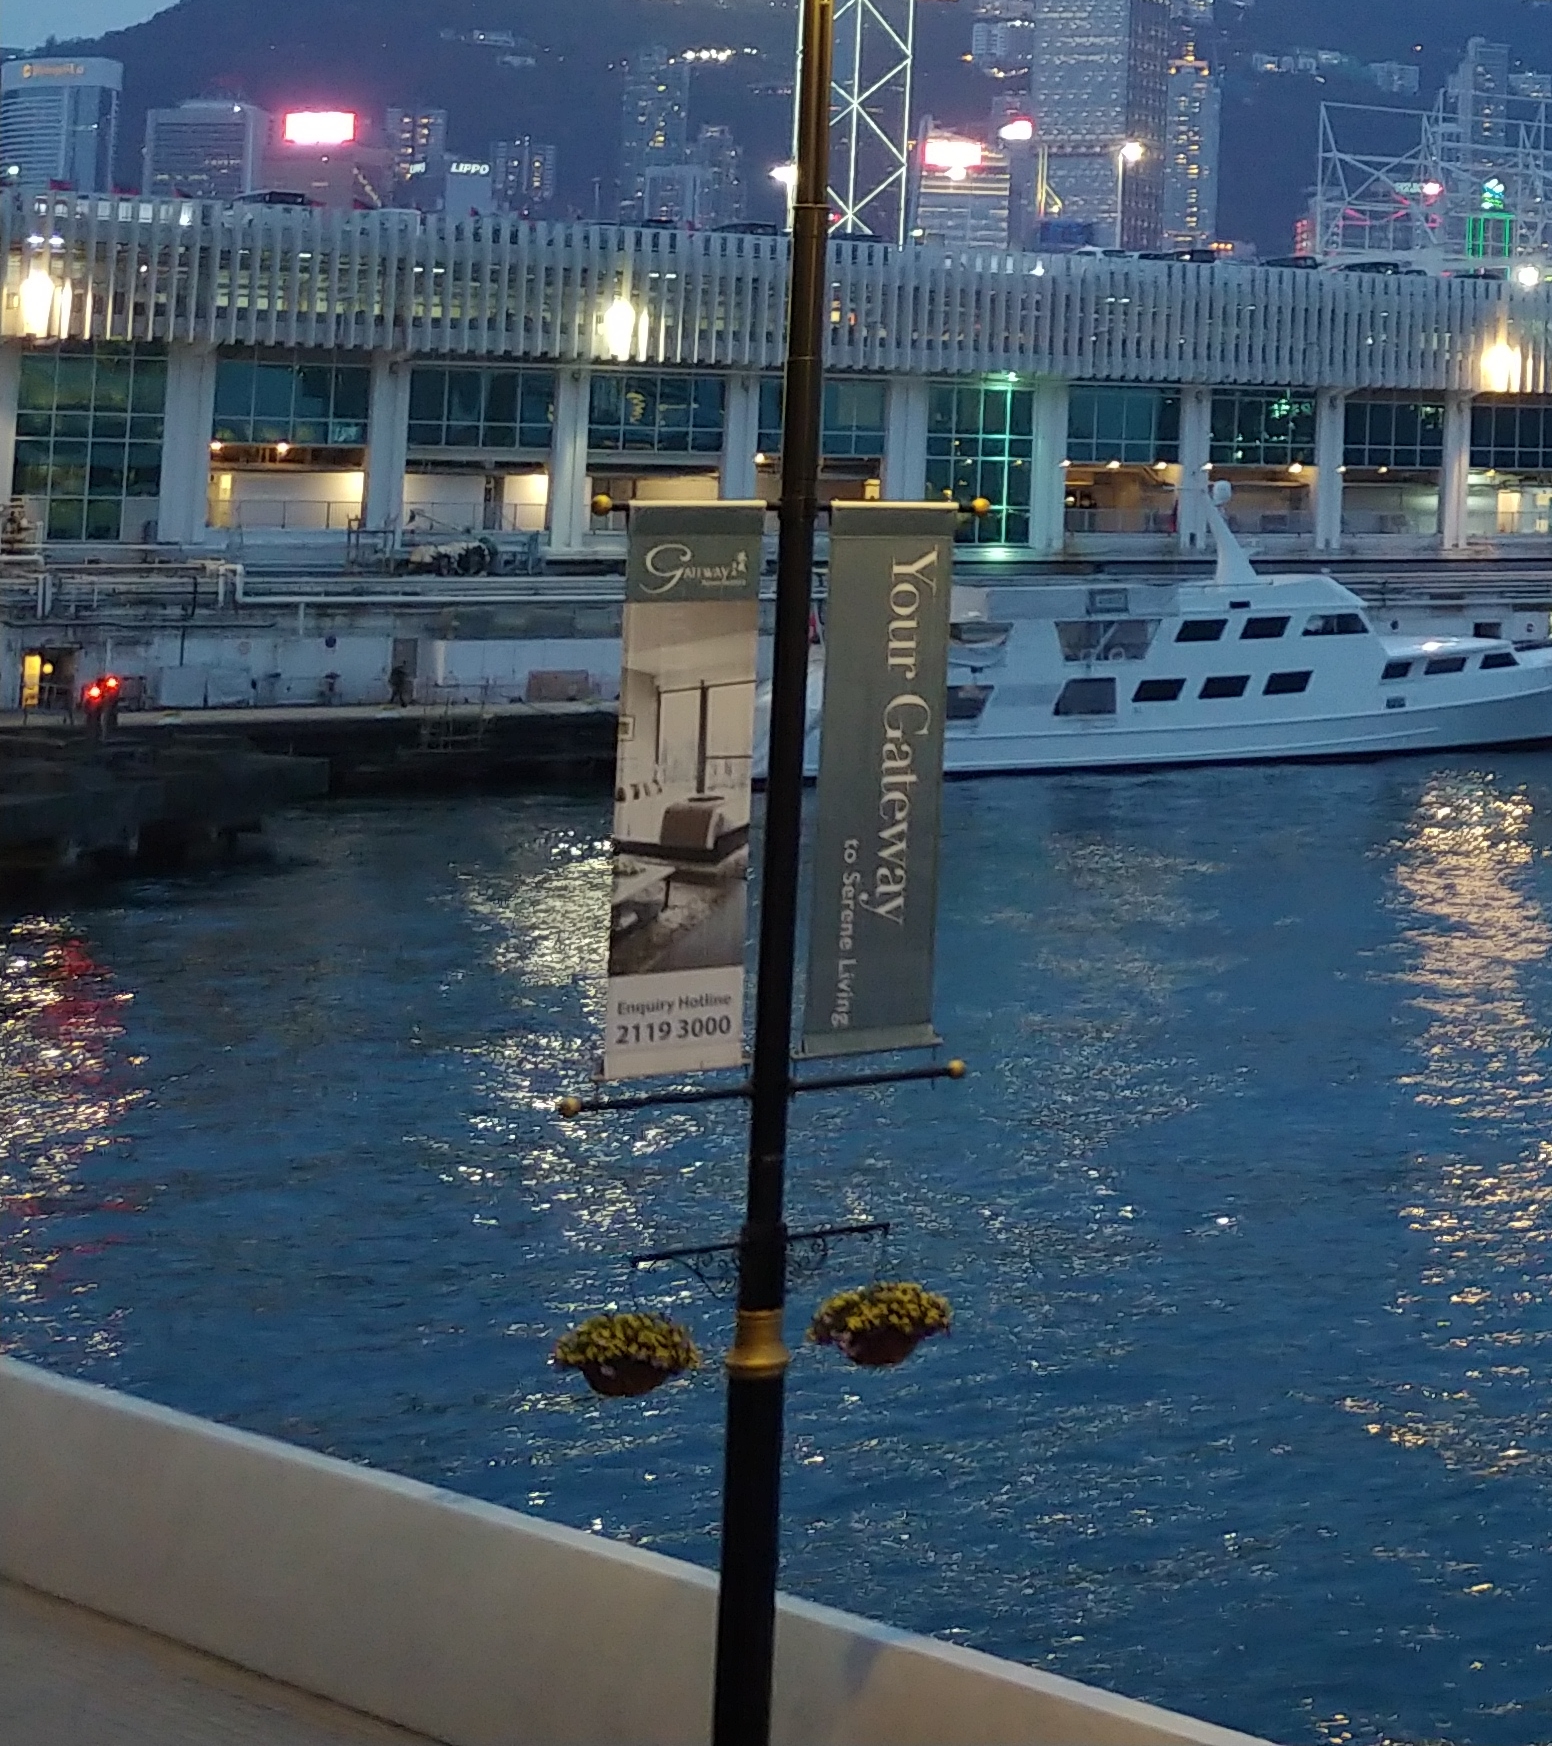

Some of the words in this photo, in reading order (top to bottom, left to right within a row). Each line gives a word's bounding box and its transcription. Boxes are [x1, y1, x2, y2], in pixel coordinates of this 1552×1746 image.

[450, 162, 490, 175] LIPPO
[887, 544, 938, 680] Your
[859, 694, 932, 926] Gateway
[843, 838, 859, 864] to
[839, 870, 861, 951] Serene
[617, 999, 675, 1016] Enquiry
[677, 993, 732, 1010] Hotline
[830, 958, 857, 1028] Living
[615, 1020, 672, 1044] 2119
[677, 1014, 732, 1039] 3000
